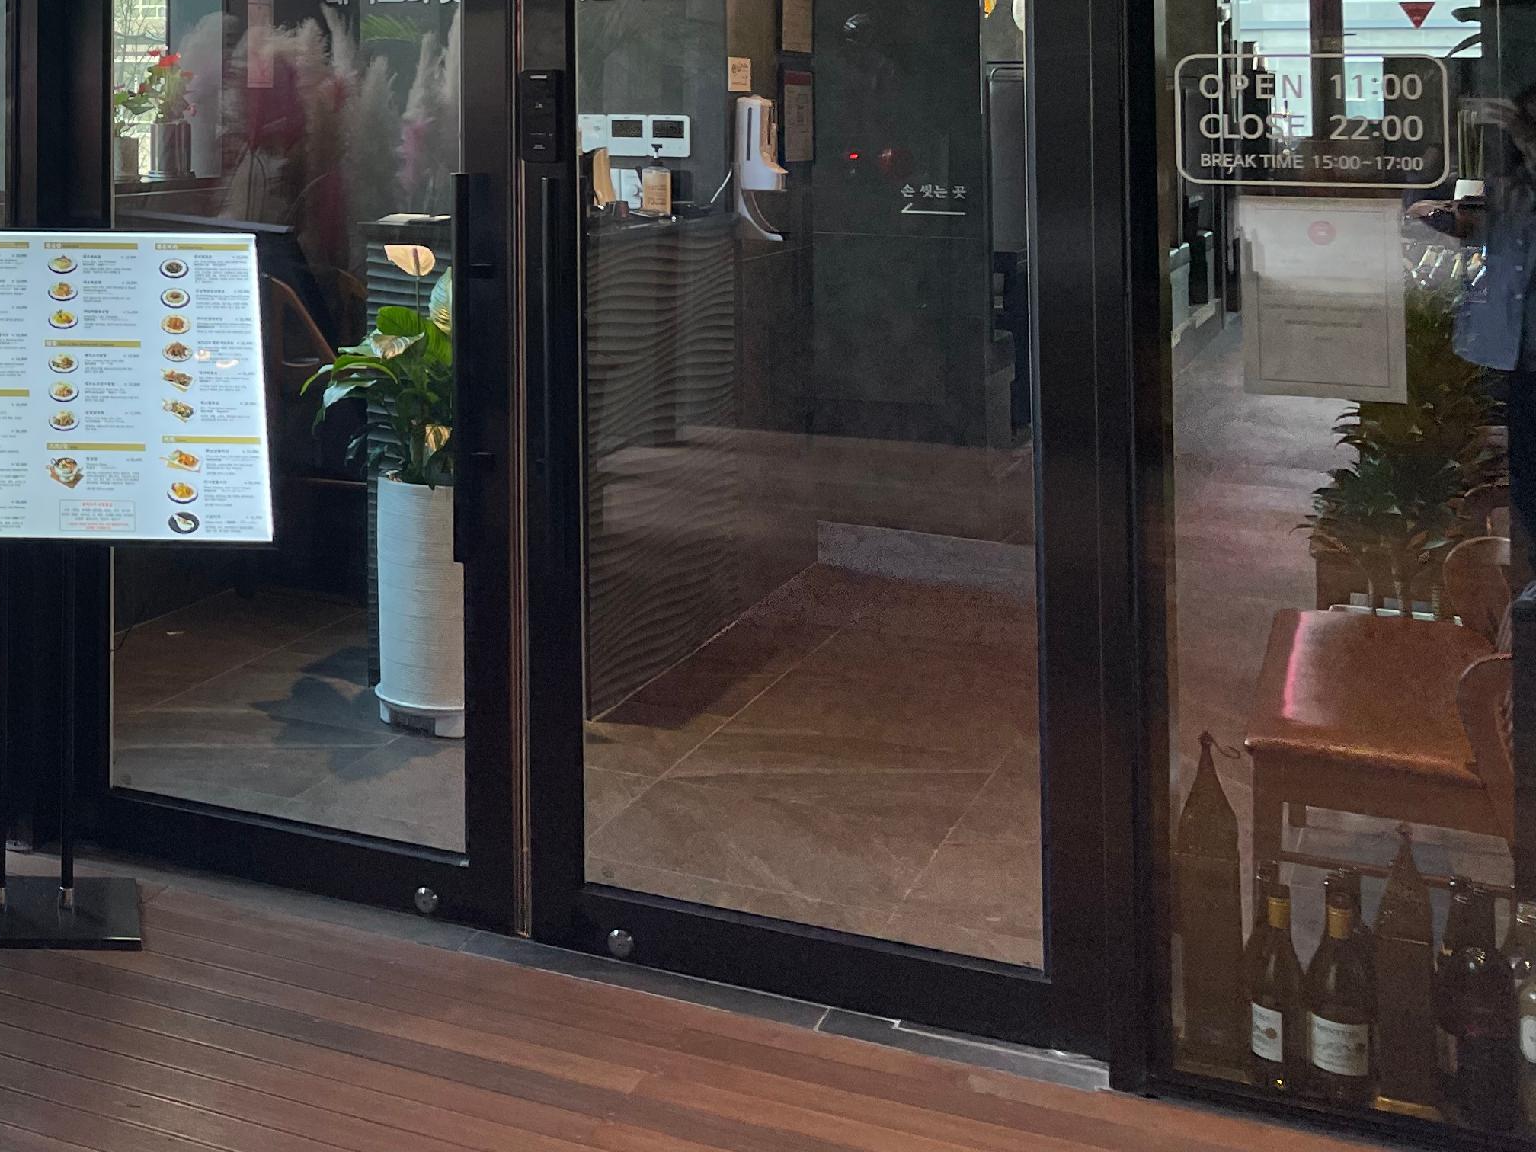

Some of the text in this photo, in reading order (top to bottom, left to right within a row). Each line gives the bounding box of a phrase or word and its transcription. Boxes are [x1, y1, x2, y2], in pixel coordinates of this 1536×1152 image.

[1199, 73, 1423, 99] OPEN 11:00
[1199, 113, 1424, 141] CLOSE 22:00
[1200, 153, 1257, 168] BREAK
[1260, 154, 1305, 169] TIME
[901, 183, 966, 199] 손 씻는 곳
